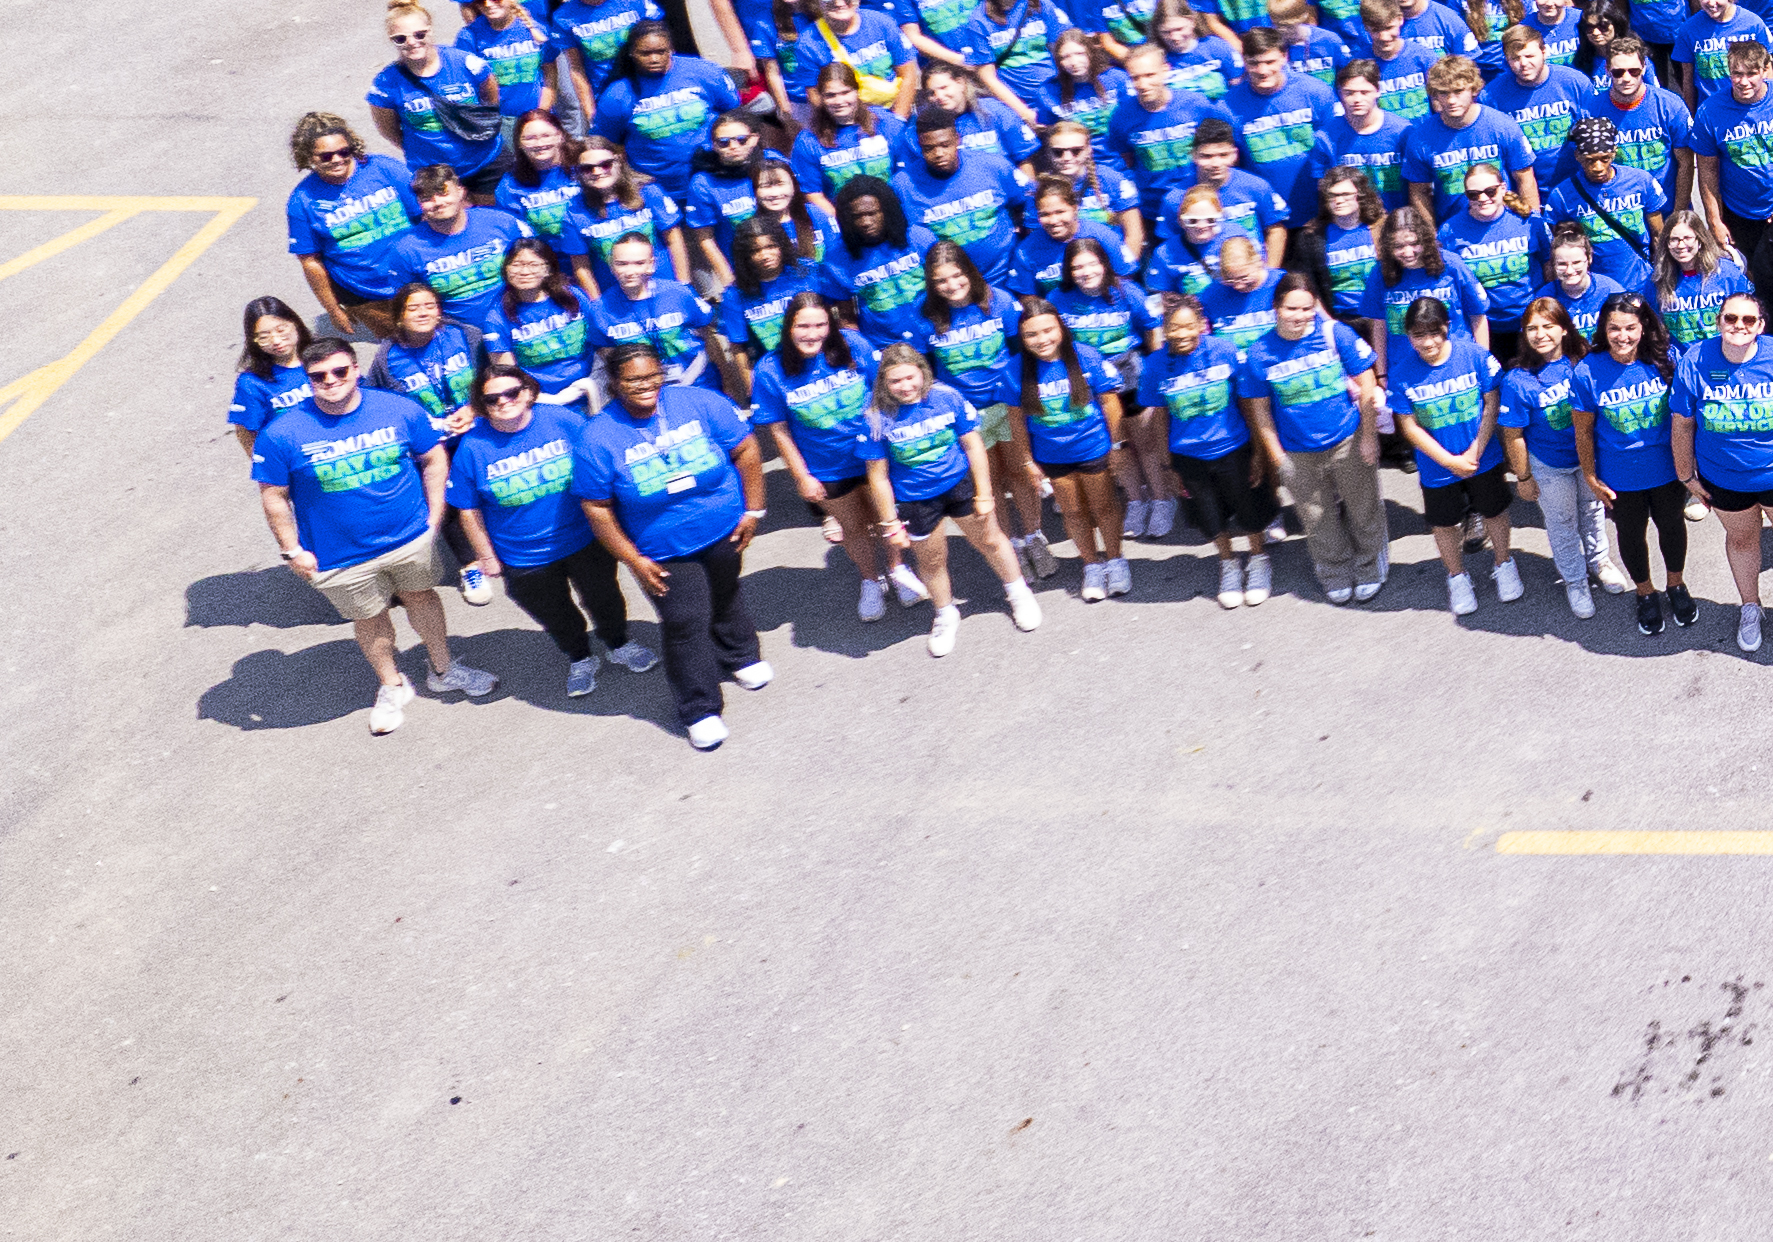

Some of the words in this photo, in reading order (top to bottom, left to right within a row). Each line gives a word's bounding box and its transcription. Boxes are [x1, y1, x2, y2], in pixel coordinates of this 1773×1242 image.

[1614, 127, 1663, 144] DM/MU
[1460, 236, 1529, 259] ADM/MU
[1405, 372, 1478, 401] ADM/MU
[1703, 402, 1745, 420] DAY
[315, 456, 367, 479] DAY
[368, 446, 402, 469] OF
[487, 439, 567, 480] ADM/MU
[489, 470, 539, 497] DAY
[537, 456, 573, 483] OF
